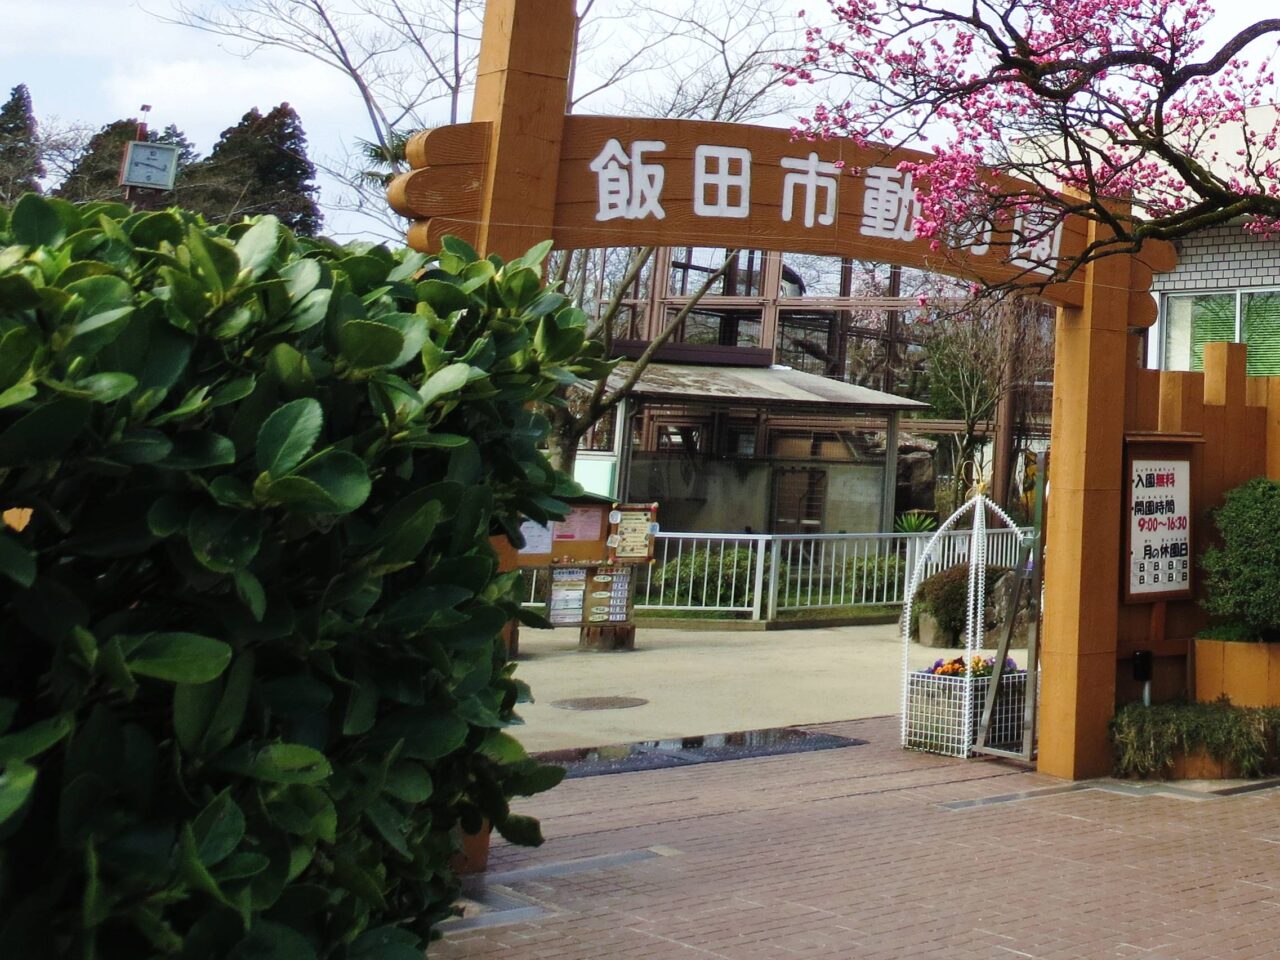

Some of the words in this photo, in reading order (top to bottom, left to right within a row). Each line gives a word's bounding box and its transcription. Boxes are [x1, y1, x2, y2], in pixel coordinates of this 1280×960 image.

[1134, 473, 1176, 489] 入園無料
[1134, 500, 1176, 516] 開園時間
[1143, 543, 1189, 560] 月の休園日
